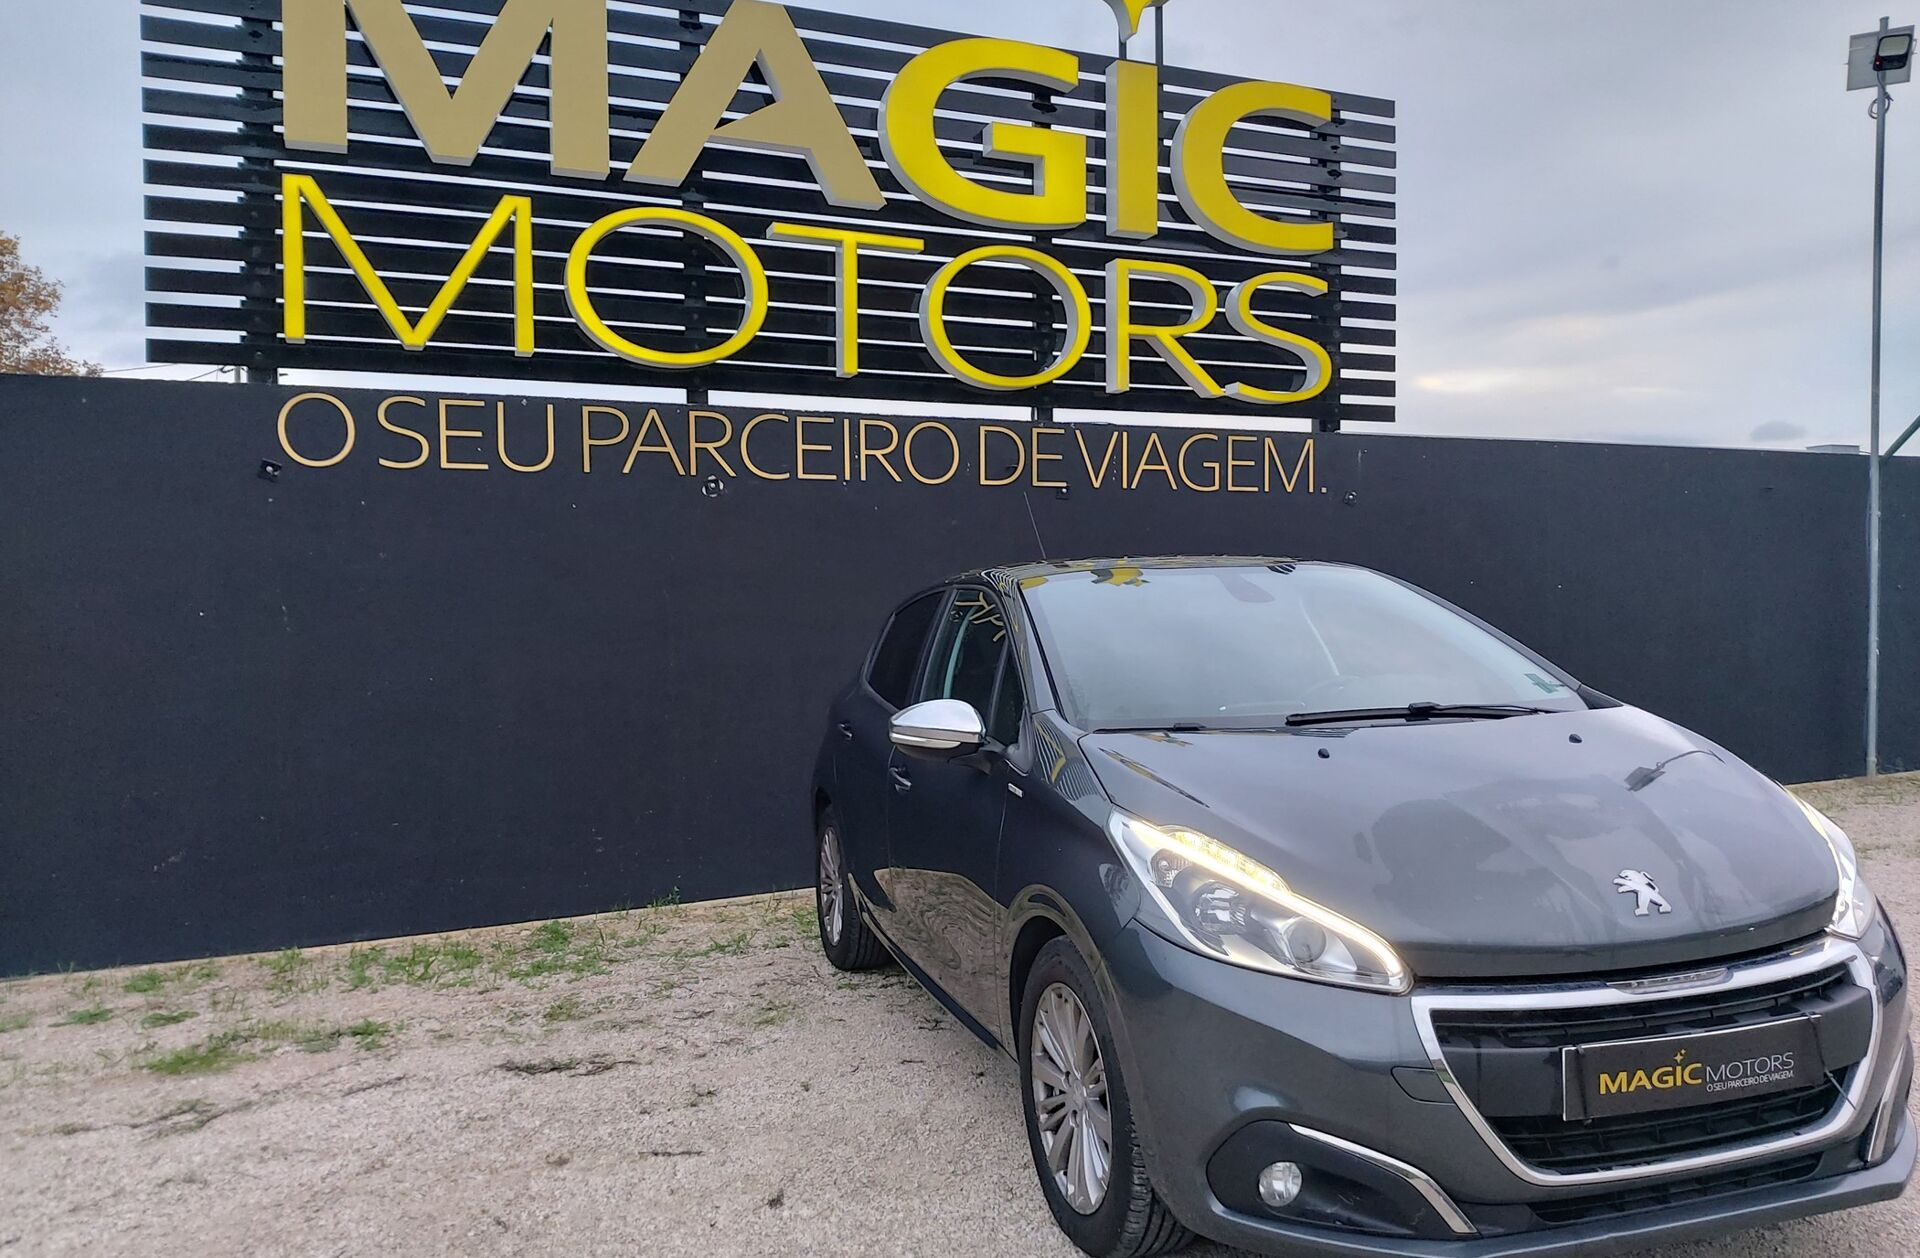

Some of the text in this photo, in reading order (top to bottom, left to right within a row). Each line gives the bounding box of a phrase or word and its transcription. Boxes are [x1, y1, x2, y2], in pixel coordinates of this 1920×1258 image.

[281, 173, 1332, 405] MOTORS
[276, 392, 1328, 495] O SEU PARCEIRO DE VIAGEM.
[1599, 1052, 1795, 1095] MAGIC MOTORS
[1713, 1081, 1728, 1092] SEU
[1727, 1075, 1760, 1089] PARCEIRO
